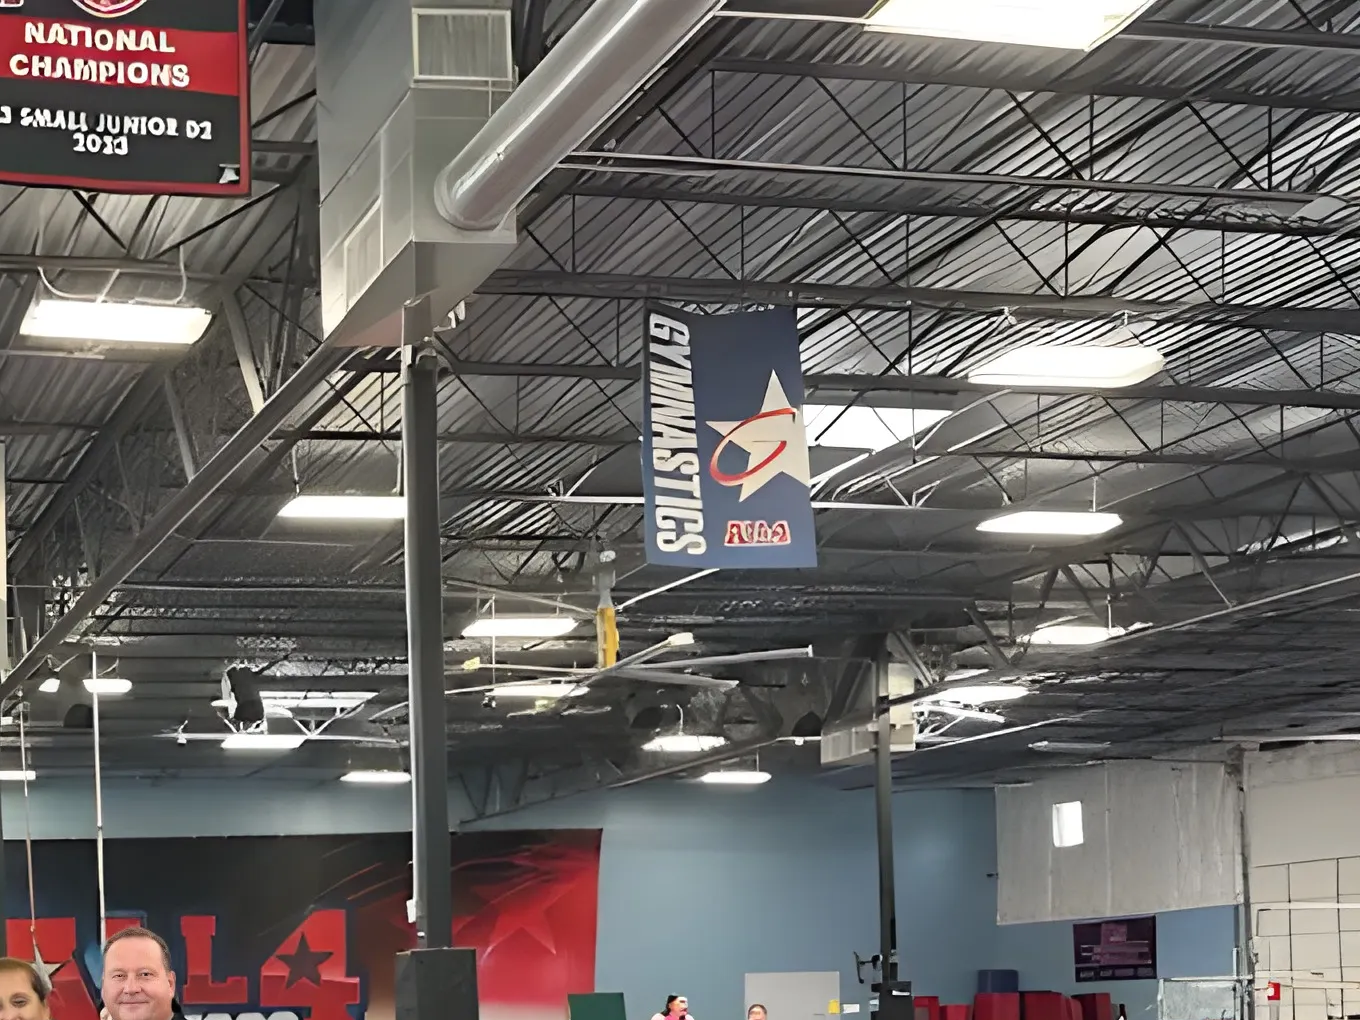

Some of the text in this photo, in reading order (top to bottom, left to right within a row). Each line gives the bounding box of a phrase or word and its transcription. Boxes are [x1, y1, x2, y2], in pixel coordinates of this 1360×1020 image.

[24, 21, 176, 53] NATIONAL
[9, 53, 191, 88] CHAMPIONS
[20, 107, 88, 132] SMALL
[96, 113, 179, 136] JUNIOR
[649, 312, 707, 555] GYMNASTICS
